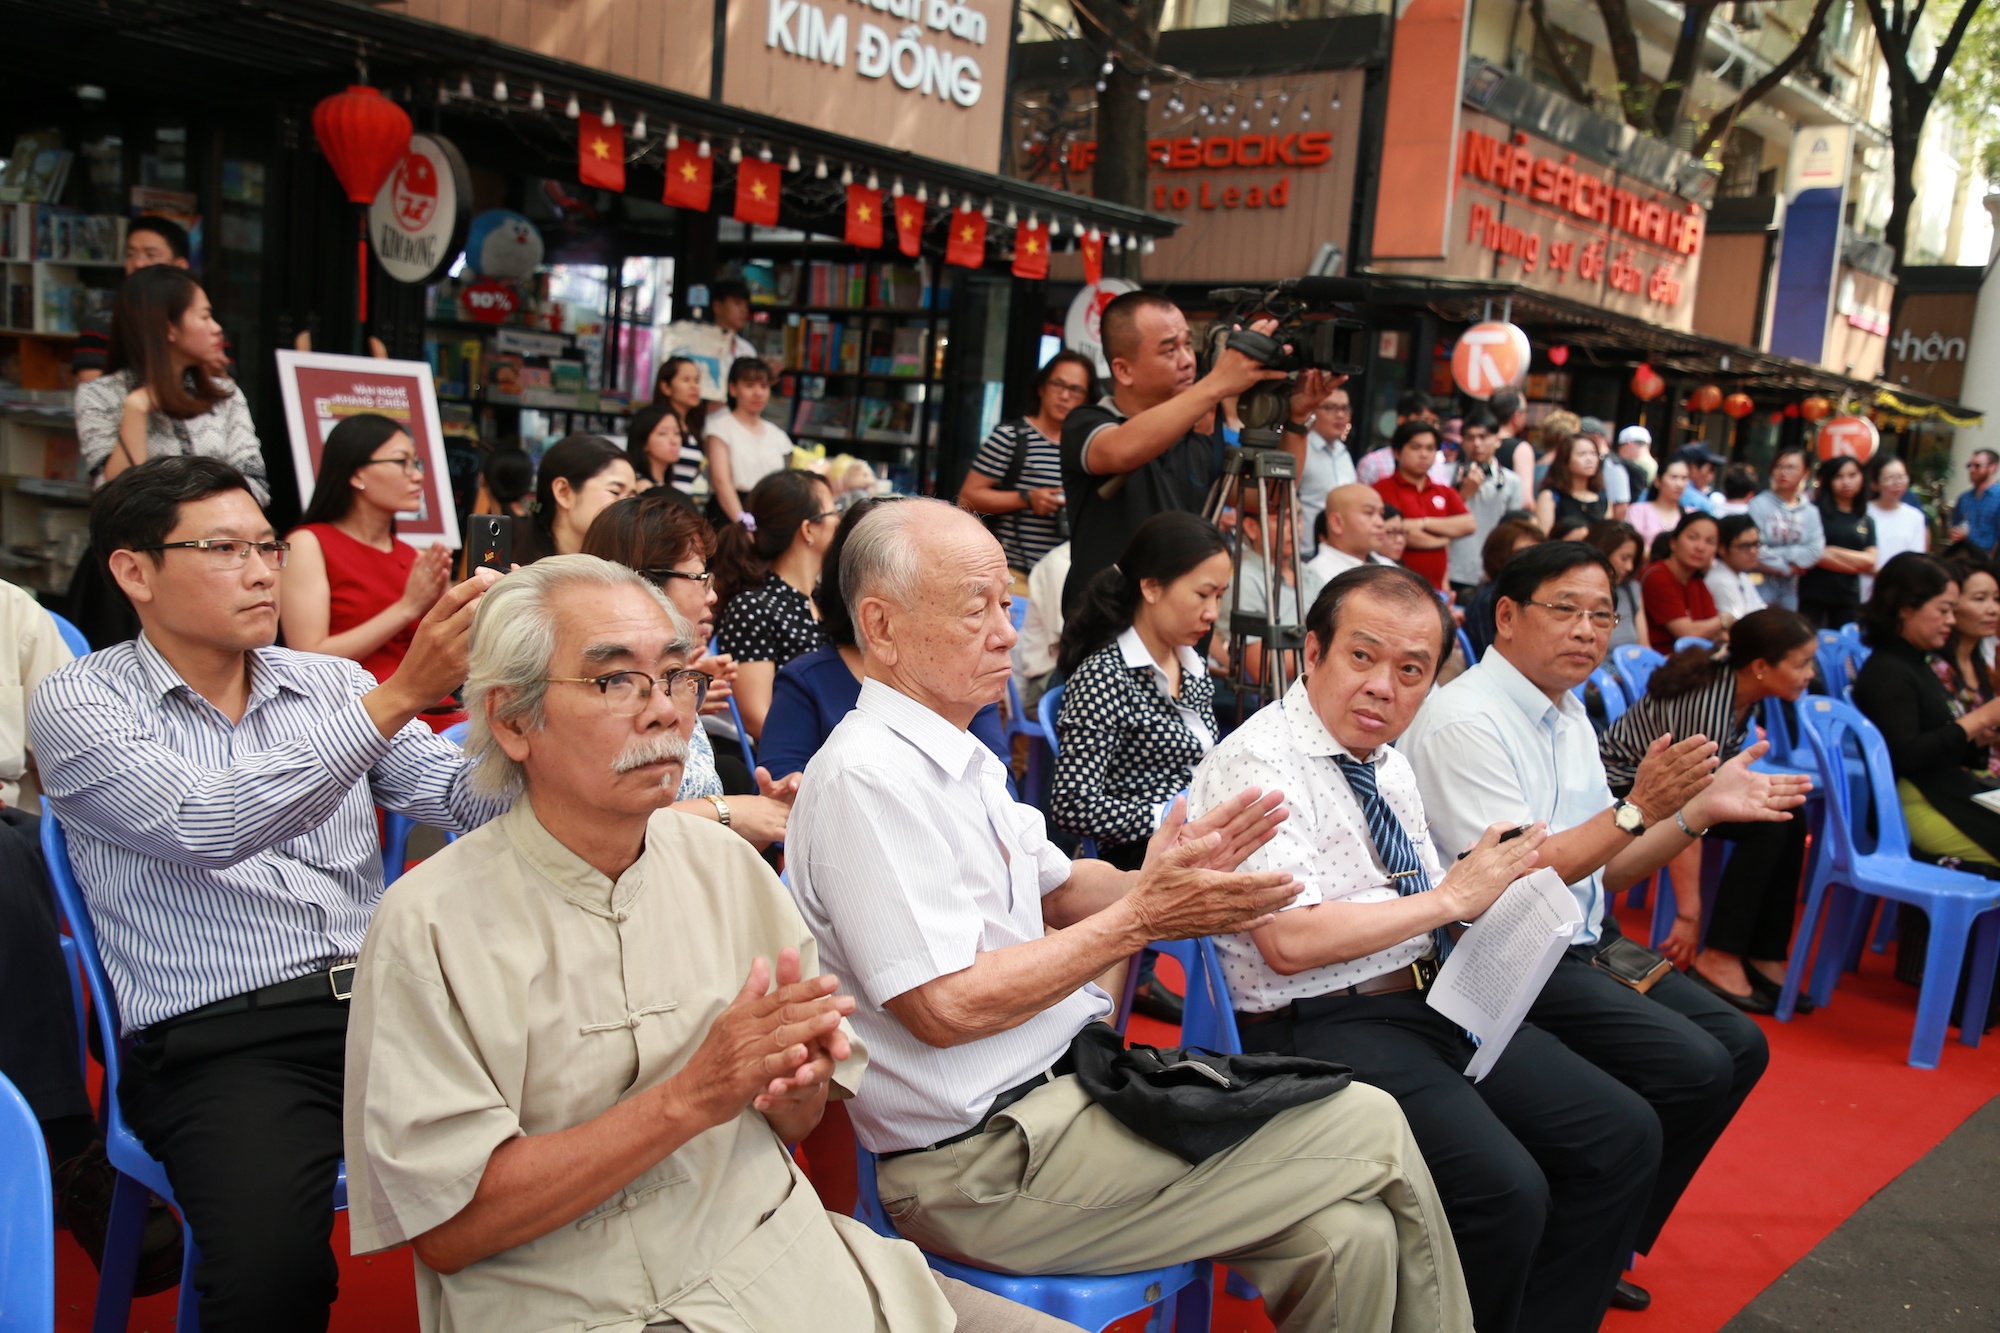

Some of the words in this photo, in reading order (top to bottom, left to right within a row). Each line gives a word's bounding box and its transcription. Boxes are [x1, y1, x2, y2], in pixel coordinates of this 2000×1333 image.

[767, 0, 848, 68] KIM
[857, 24, 983, 107] ĐỒNG
[1153, 183, 1191, 210] to
[1199, 175, 1290, 209] Lead
[1464, 129, 1534, 195] NHÀ
[1530, 152, 1613, 224] SÁCH
[1610, 190, 1670, 246] THÁI
[1668, 202, 1705, 255] HÀ
[1468, 203, 1541, 273] Phụng
[1888, 327, 1967, 364] hôn
